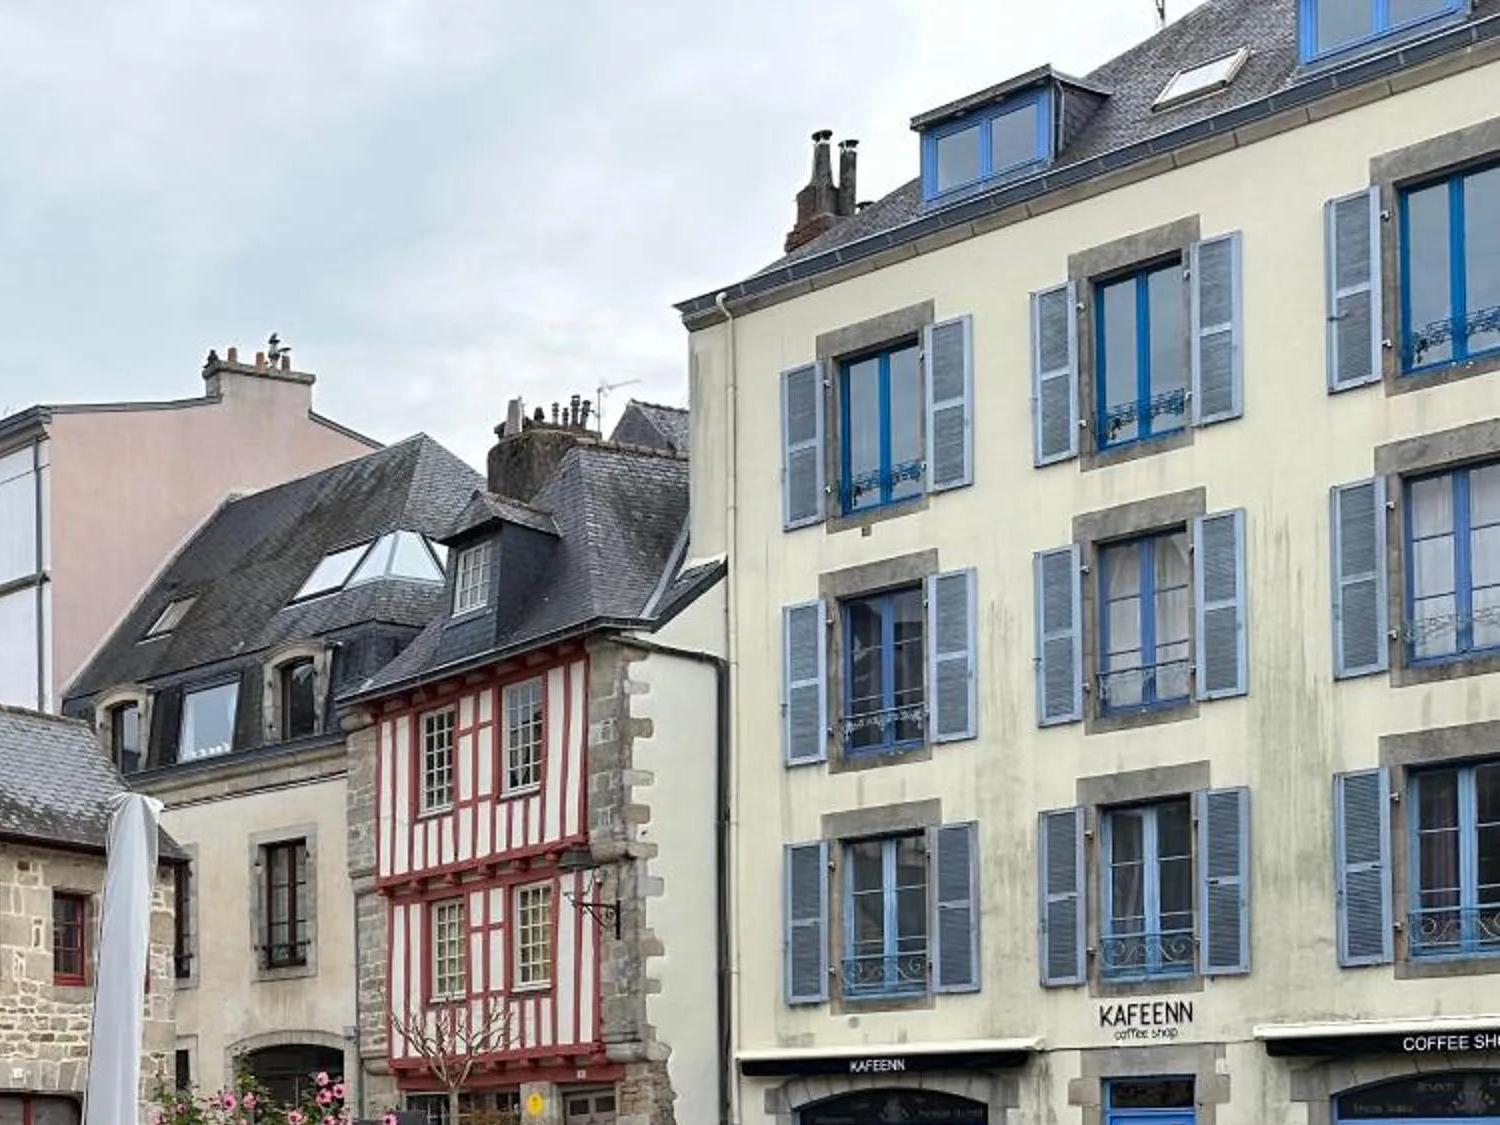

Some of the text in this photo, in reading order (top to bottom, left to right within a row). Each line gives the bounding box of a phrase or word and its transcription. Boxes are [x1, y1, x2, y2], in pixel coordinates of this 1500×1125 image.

[1100, 1000, 1194, 1028] KAFEENN
[1113, 1026, 1179, 1041] coffee shop
[1403, 1033, 1500, 1051] COFFEE SH
[850, 1058, 905, 1073] KAFEENN
